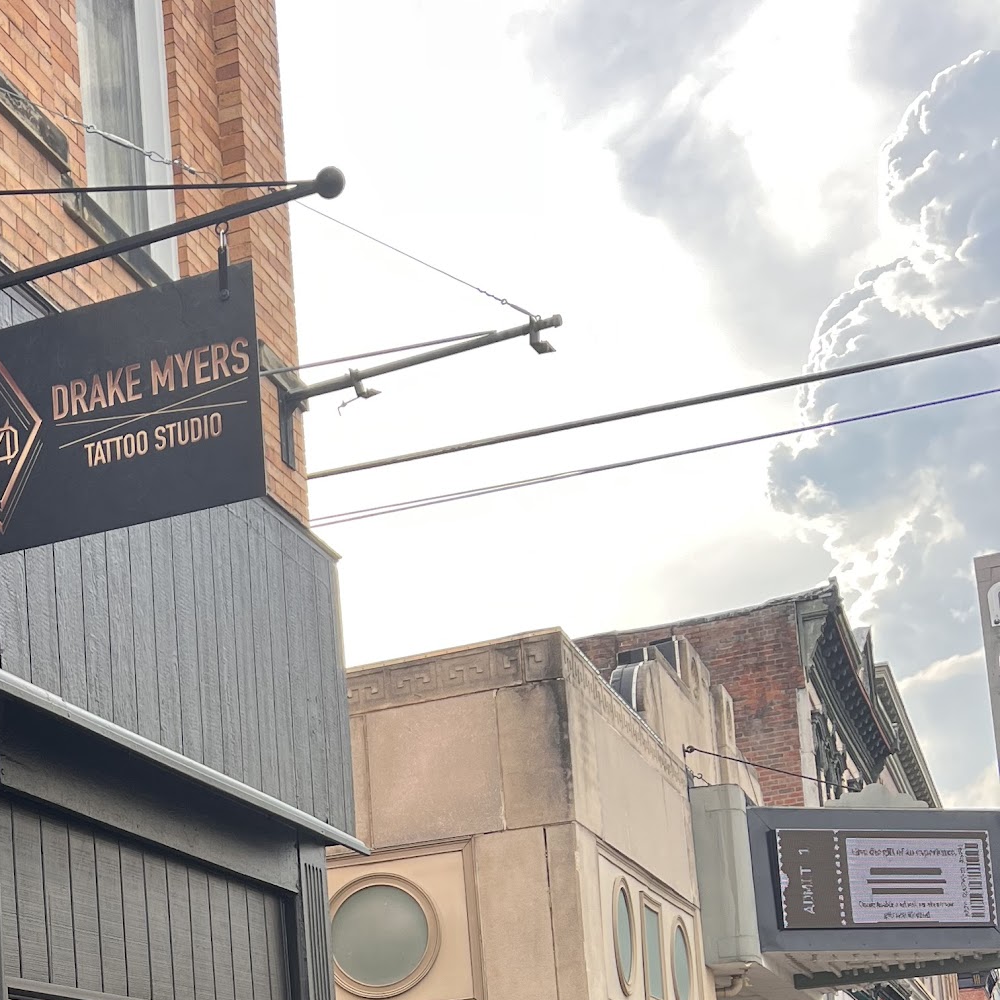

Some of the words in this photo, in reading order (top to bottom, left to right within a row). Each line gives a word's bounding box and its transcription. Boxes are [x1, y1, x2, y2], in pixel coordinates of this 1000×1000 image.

[51, 363, 143, 420] DRAKE
[150, 336, 250, 396] MYERS
[84, 430, 149, 467] TATTOO
[154, 412, 223, 451] STUDIO
[799, 865, 815, 914] ADMIT
